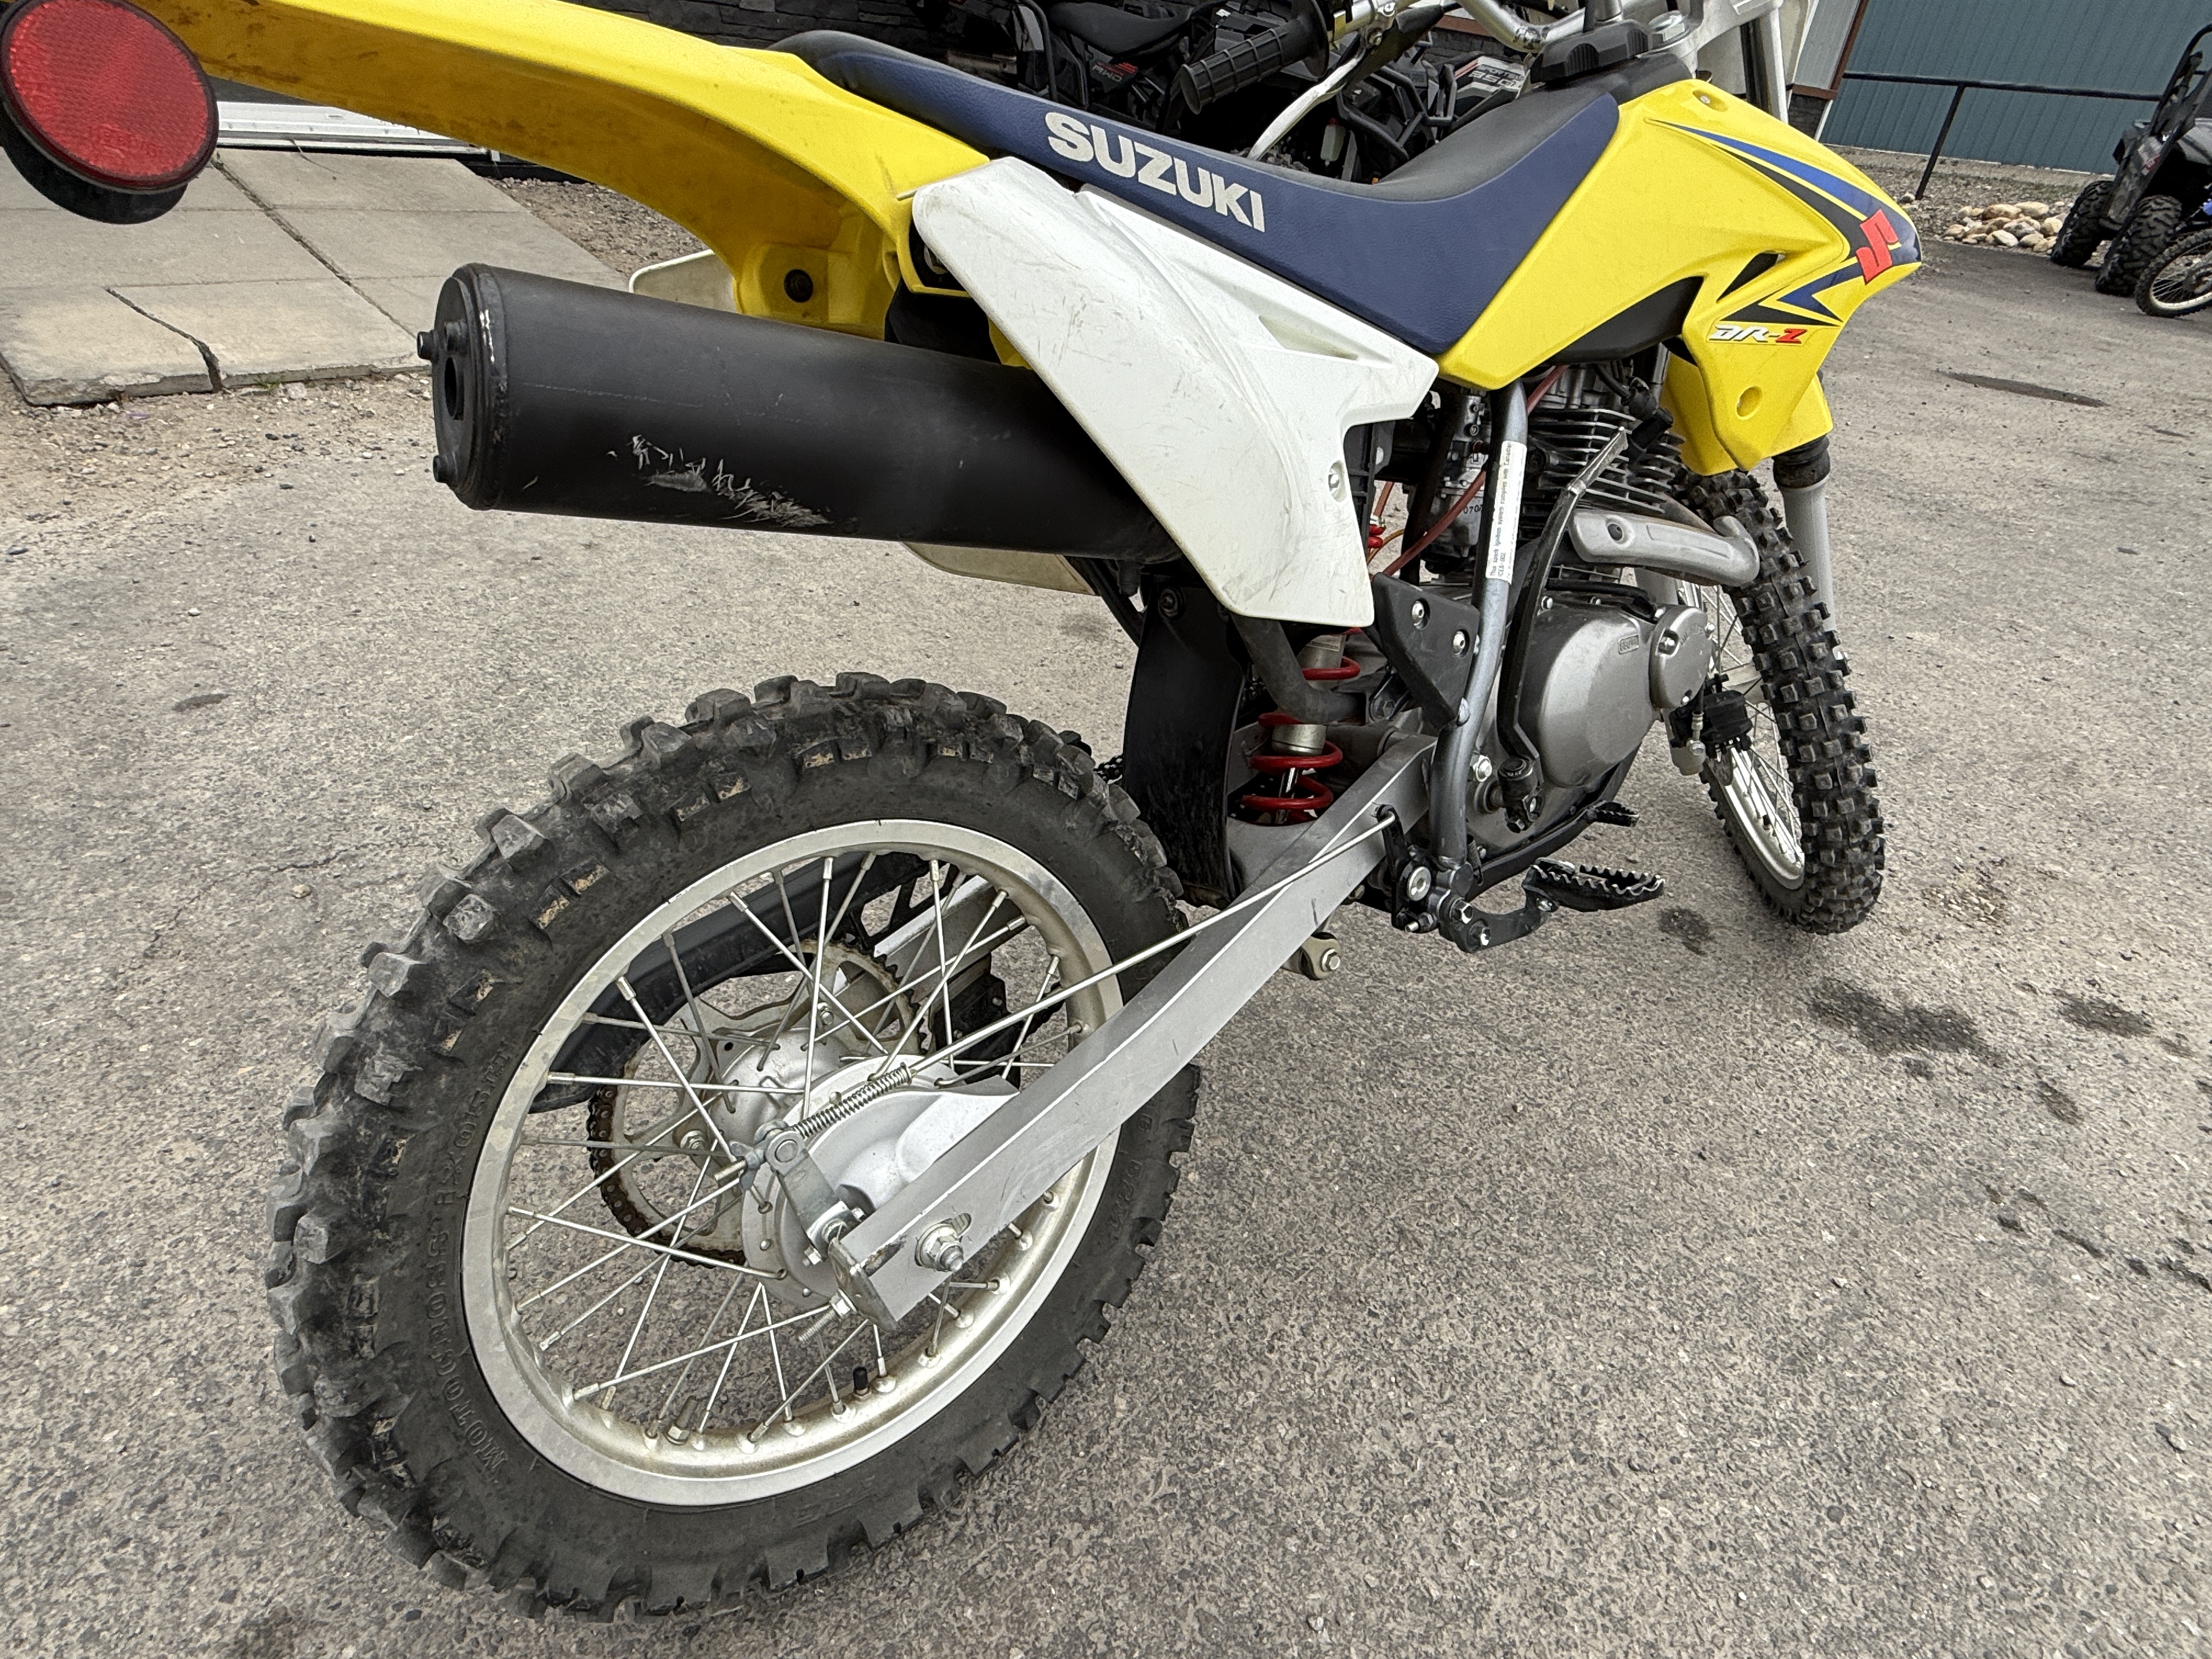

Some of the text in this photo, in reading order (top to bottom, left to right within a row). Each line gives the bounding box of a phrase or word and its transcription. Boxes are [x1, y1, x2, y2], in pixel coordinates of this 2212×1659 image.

[1476, 64, 1525, 82] SPORTSM
[1045, 112, 1265, 233] SUZUKI
[1709, 324, 1808, 344] DR-Z
